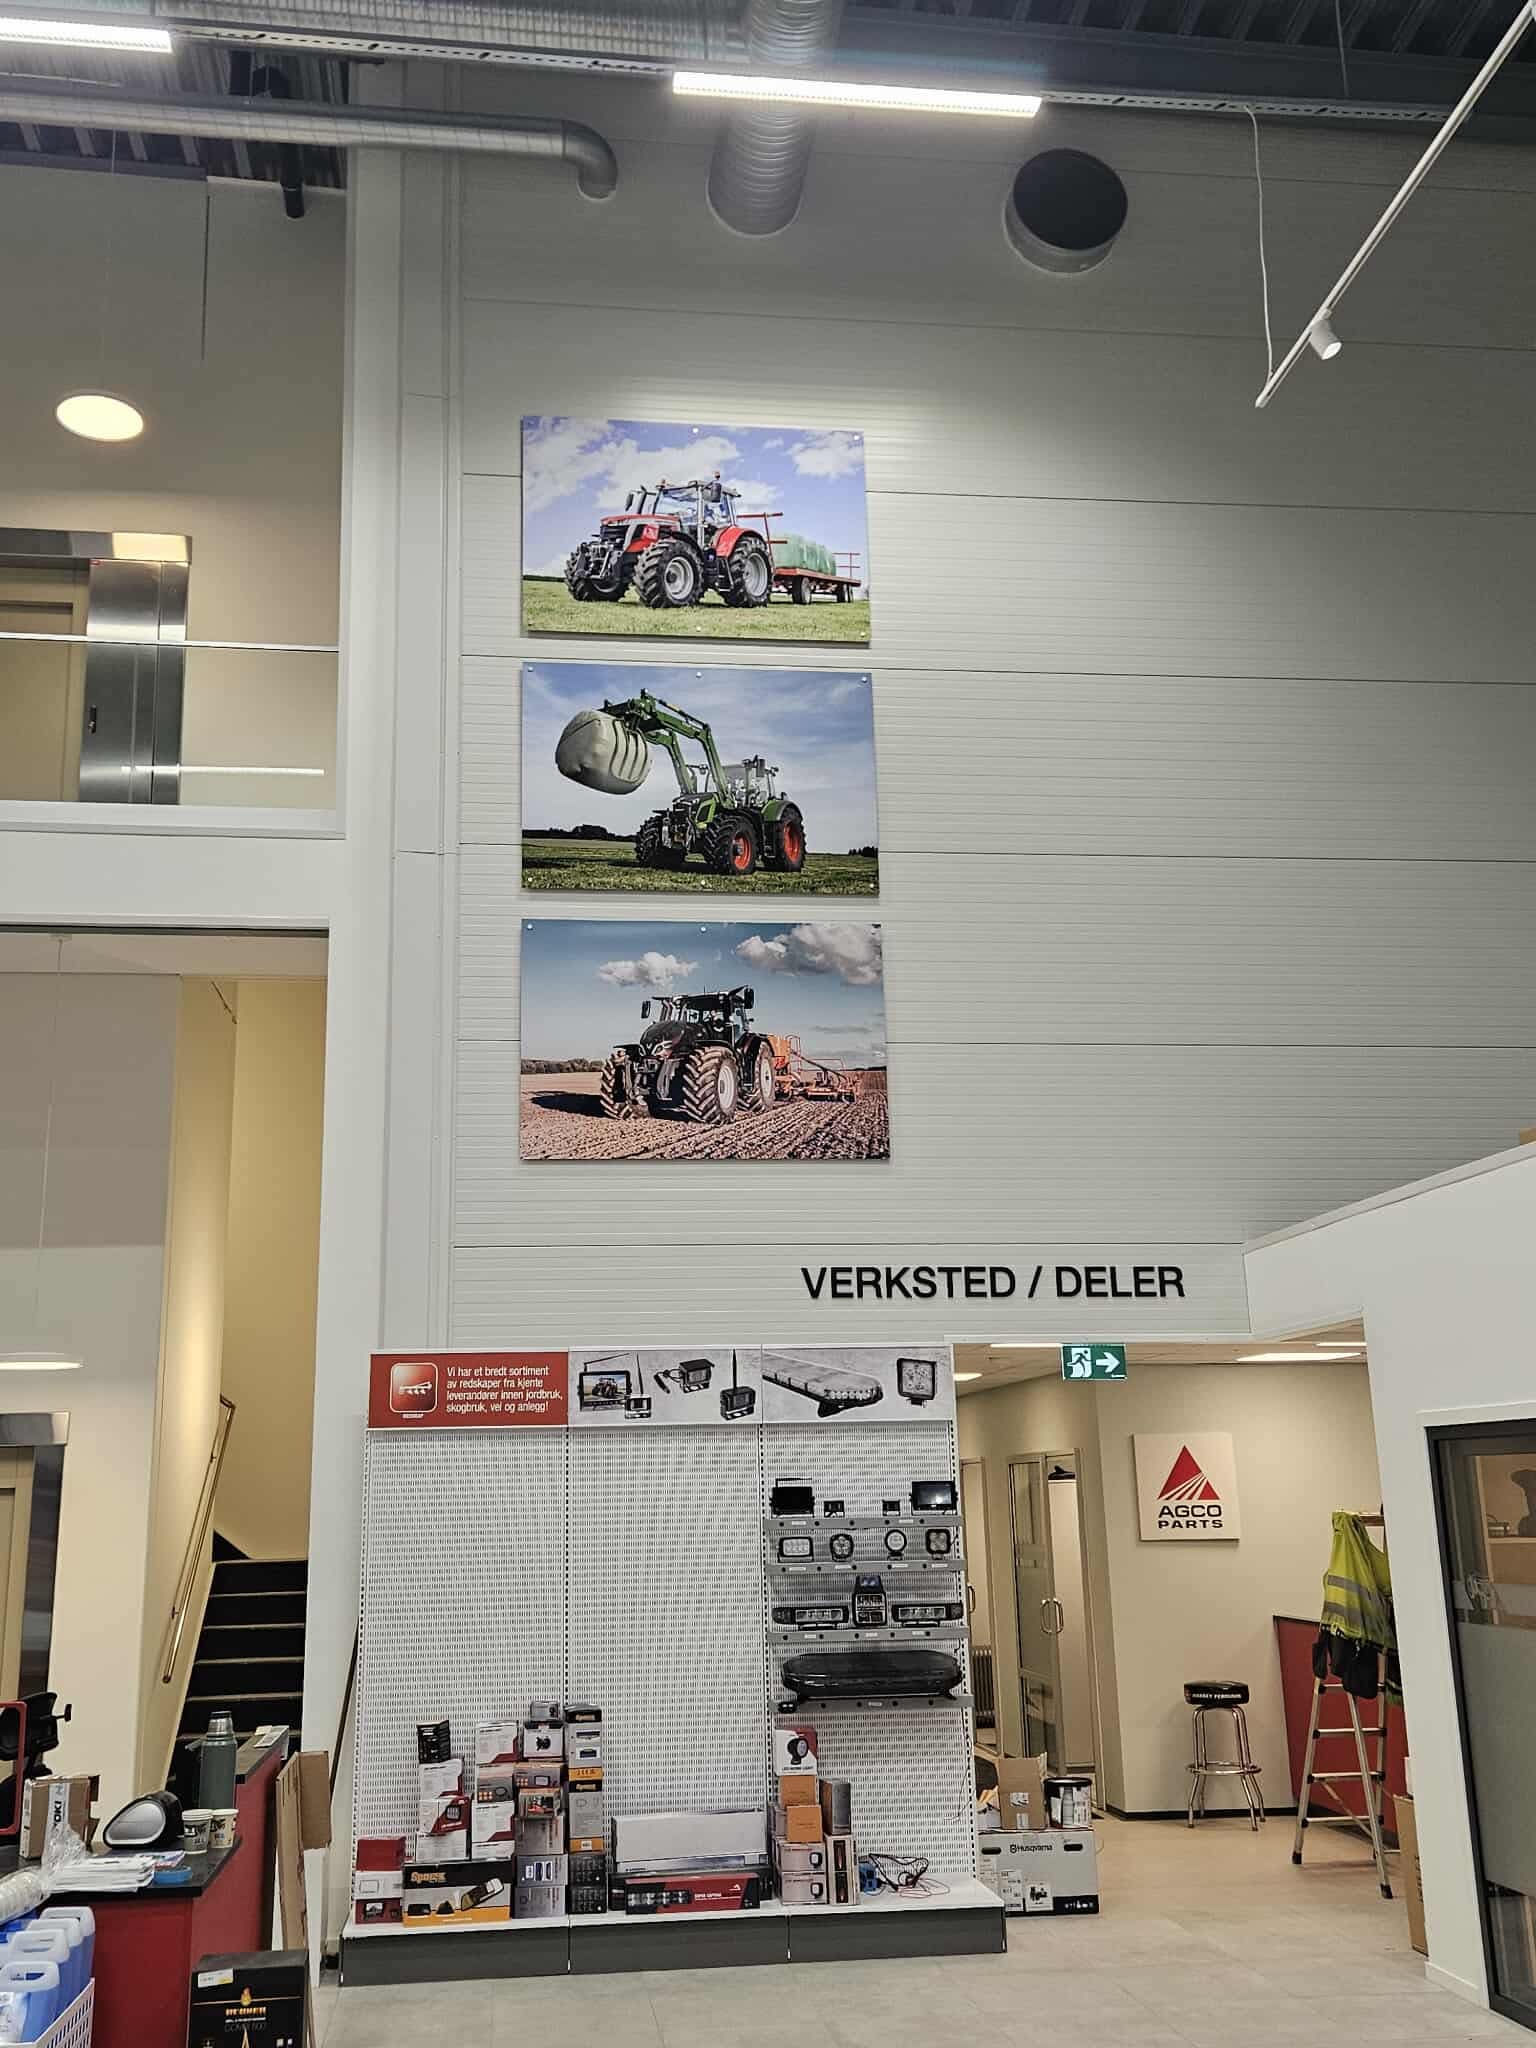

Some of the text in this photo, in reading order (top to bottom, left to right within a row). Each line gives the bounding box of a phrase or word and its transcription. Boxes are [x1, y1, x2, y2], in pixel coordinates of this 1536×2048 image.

[801, 1265, 1185, 1299] VERKSTED / DELER
[447, 1366, 549, 1377] Vi har et bredt sortiment
[447, 1377, 544, 1390] av redskaper fra kjente
[447, 1389, 563, 1401] leverandører innen jordbruk,
[447, 1401, 549, 1414] skogbruk, vei og anlegg!
[1158, 1504, 1222, 1518] AGCO
[1158, 1519, 1223, 1529] PARTS
[1017, 1844, 1053, 1853] Husqvarna
